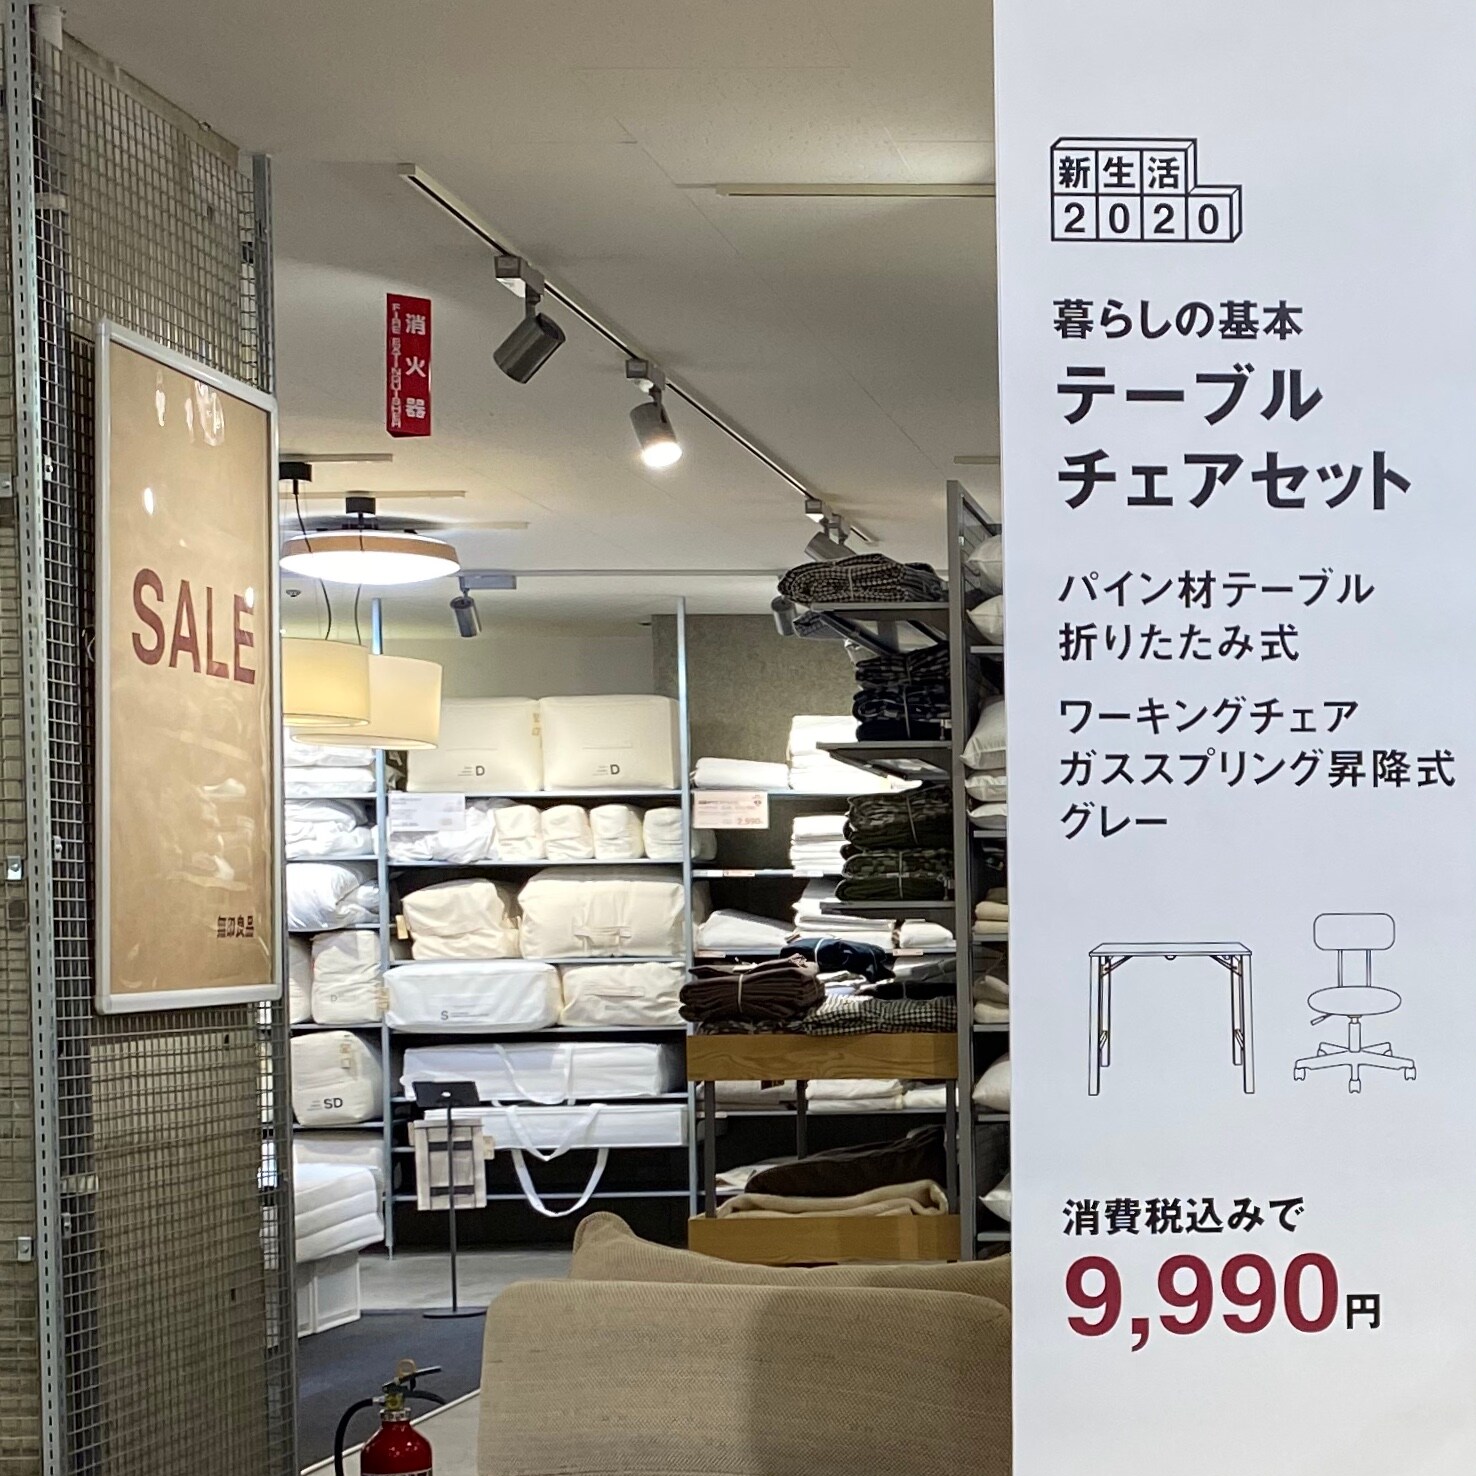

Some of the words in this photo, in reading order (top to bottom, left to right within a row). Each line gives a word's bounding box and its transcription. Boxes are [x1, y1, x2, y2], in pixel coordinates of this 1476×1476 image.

[1058, 155, 1181, 189] 新生活
[1064, 202, 1219, 235] 2020
[1052, 298, 1304, 341] 暮らしの基本
[405, 313, 427, 420] 消火器
[1056, 362, 1323, 426] テーブル
[1058, 448, 1412, 511] チェアセット
[1058, 567, 1375, 609] パイン材テーブル
[132, 568, 256, 685] SALE
[1058, 622, 1300, 662] 折りたたみ式
[1060, 695, 1359, 735] ワーキングチェア
[475, 765, 485, 776] D
[610, 764, 620, 775] D
[1059, 746, 1456, 789] ガススプリング昇降式
[1060, 801, 1168, 840] グレー
[440, 1010, 449, 1021] S
[323, 1097, 343, 1110] SD
[1062, 1196, 1305, 1236] 消費税込みで
